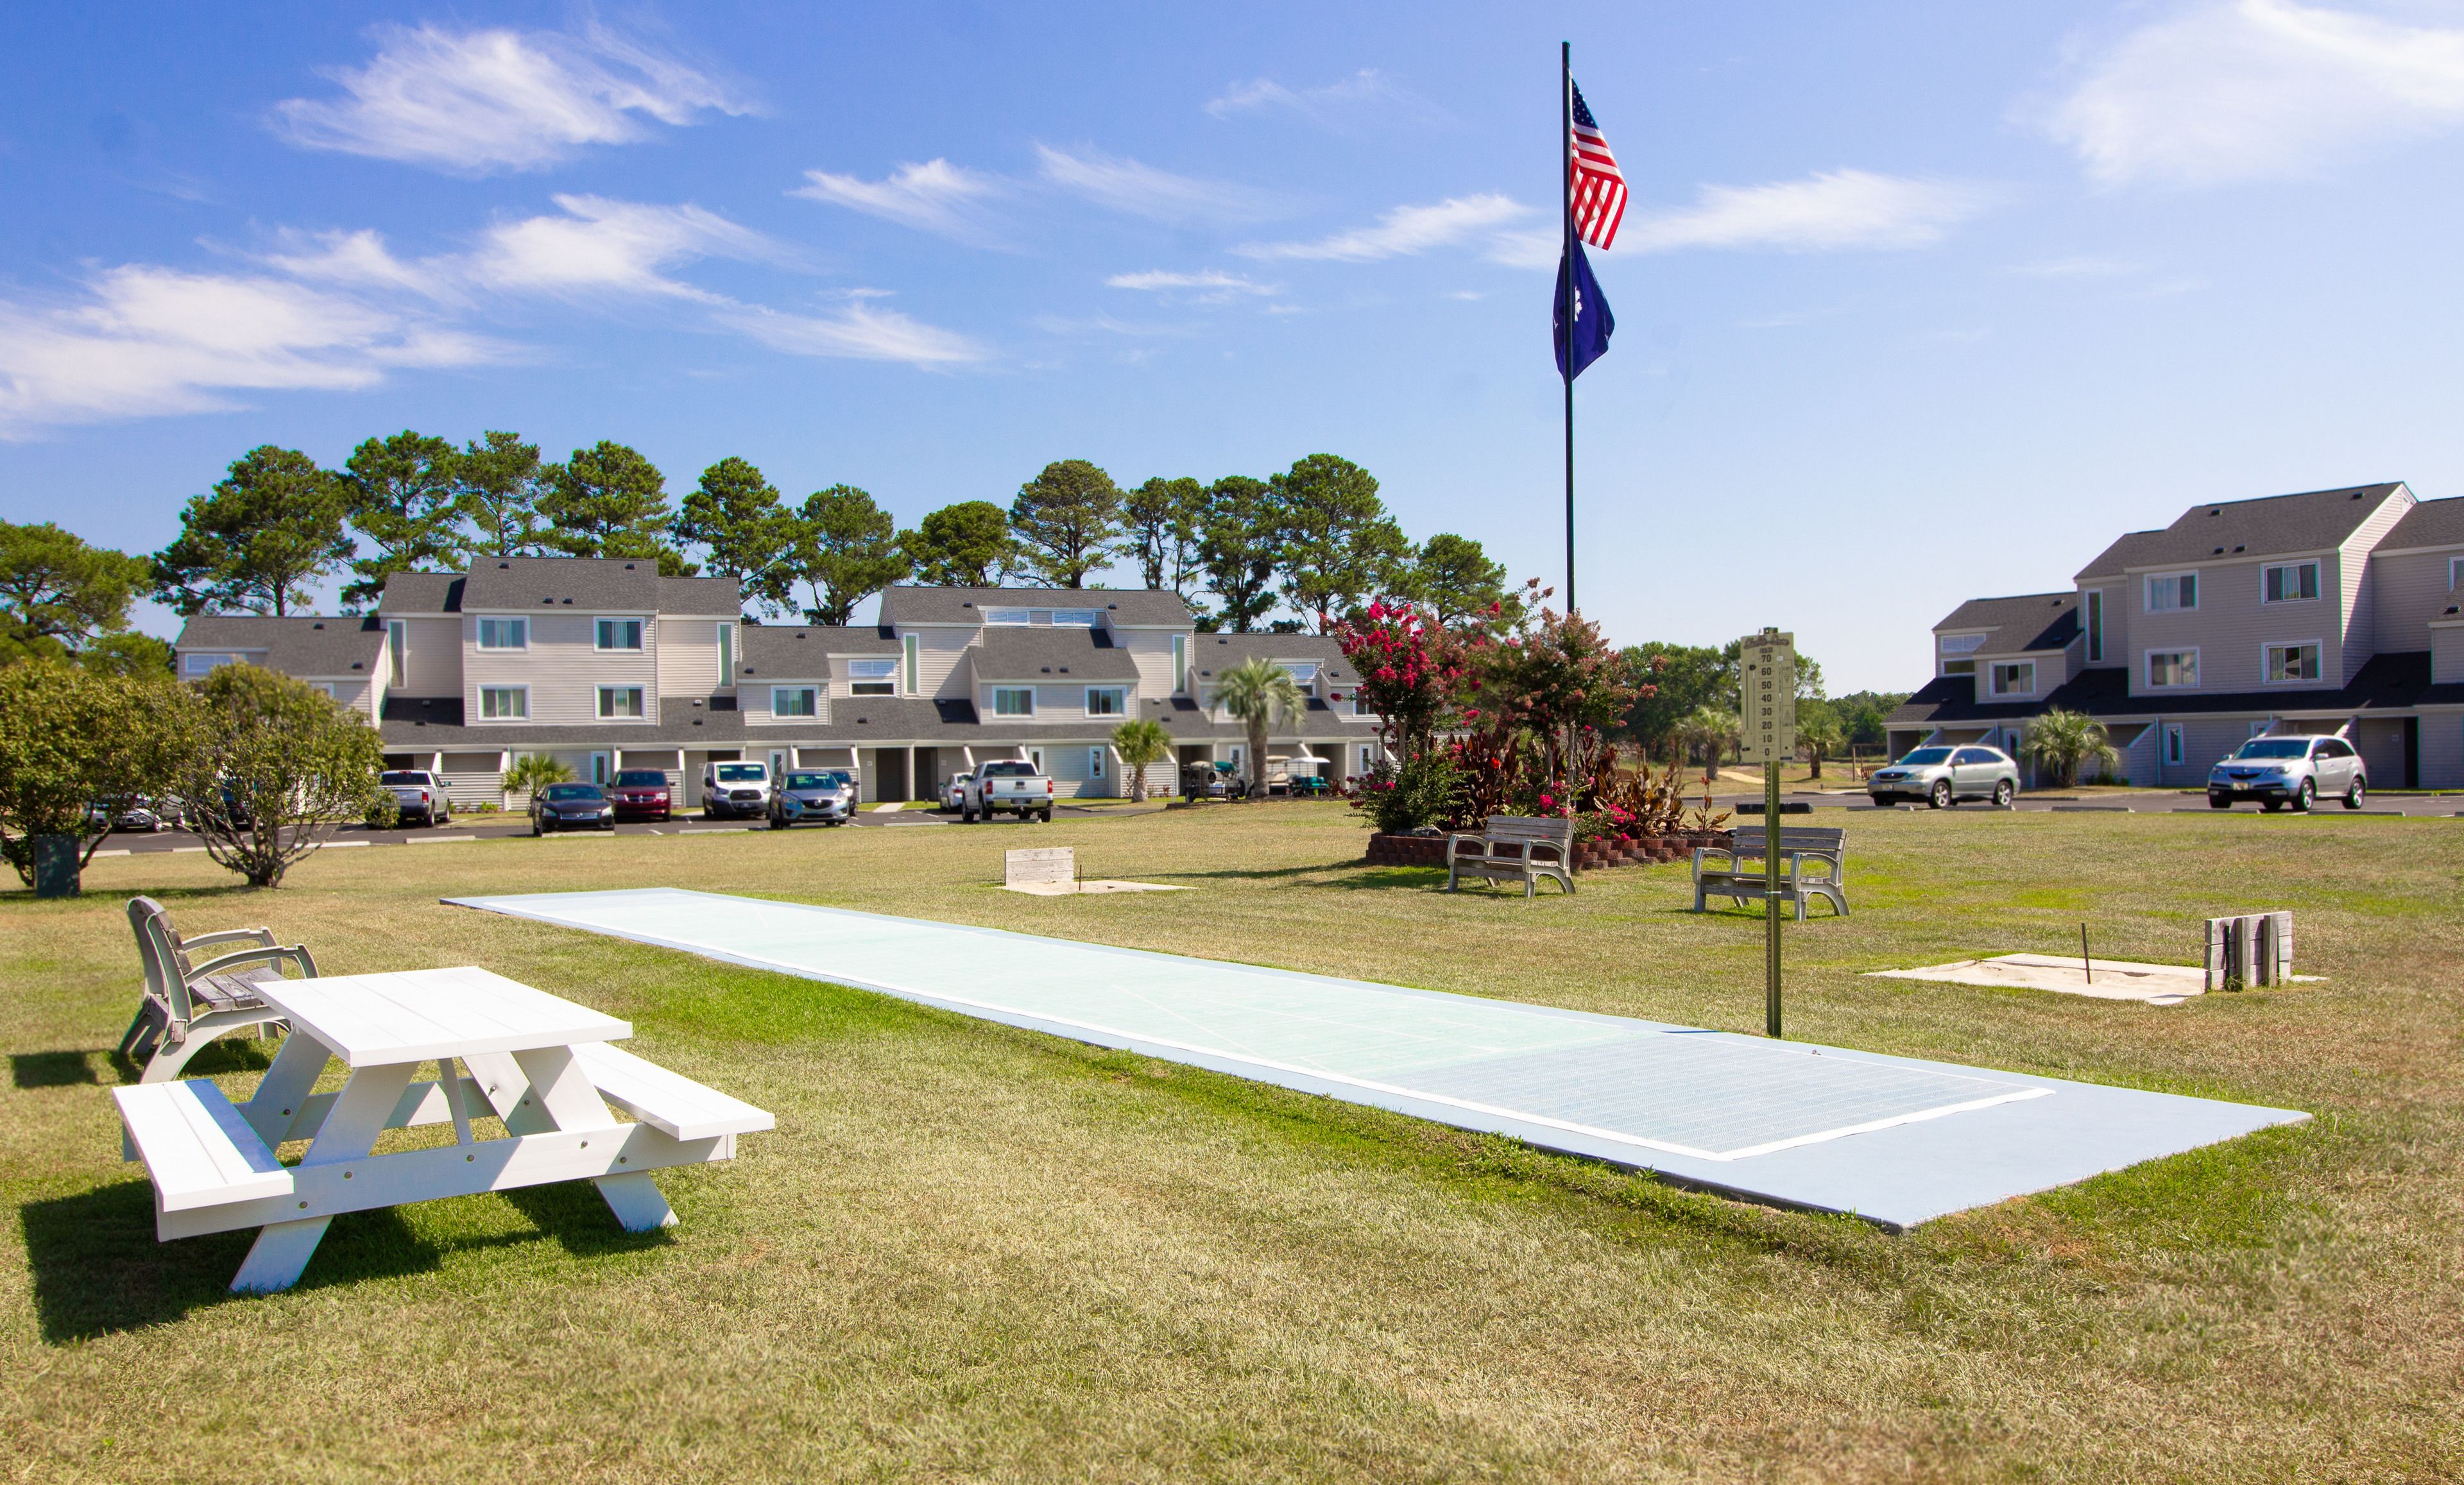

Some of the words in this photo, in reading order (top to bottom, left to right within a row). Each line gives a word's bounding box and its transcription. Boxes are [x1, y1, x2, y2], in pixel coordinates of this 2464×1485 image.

[1761, 654, 1772, 663] 70
[1761, 667, 1772, 675] 60
[1761, 681, 1772, 690] 50
[1761, 694, 1772, 702] 40
[1761, 708, 1772, 716] 30
[1762, 721, 1772, 729] 20
[1763, 734, 1772, 743] 10
